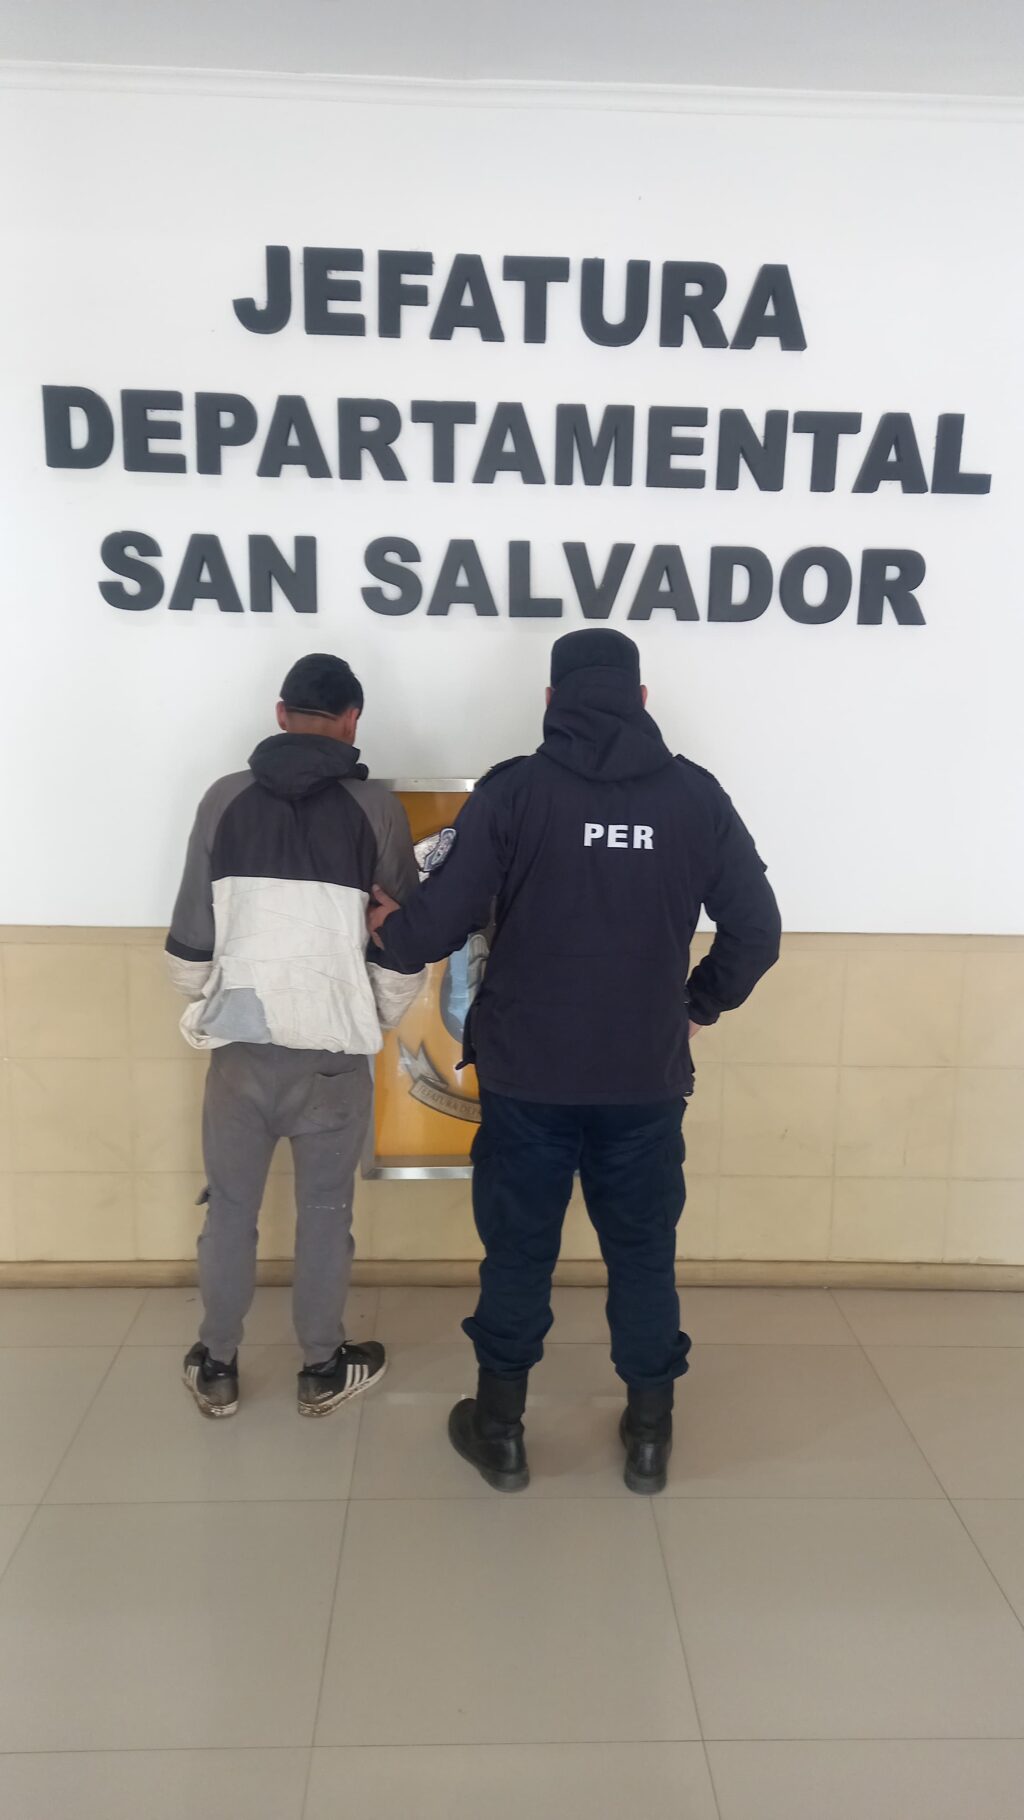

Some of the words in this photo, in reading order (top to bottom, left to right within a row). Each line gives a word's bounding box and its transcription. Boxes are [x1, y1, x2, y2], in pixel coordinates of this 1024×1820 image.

[233, 245, 807, 352] JEFATURA
[42, 385, 991, 495] DEPARTAMENTAL
[99, 530, 317, 614] SAN
[362, 536, 926, 626] SALVADOR
[583, 822, 654, 850] PER
